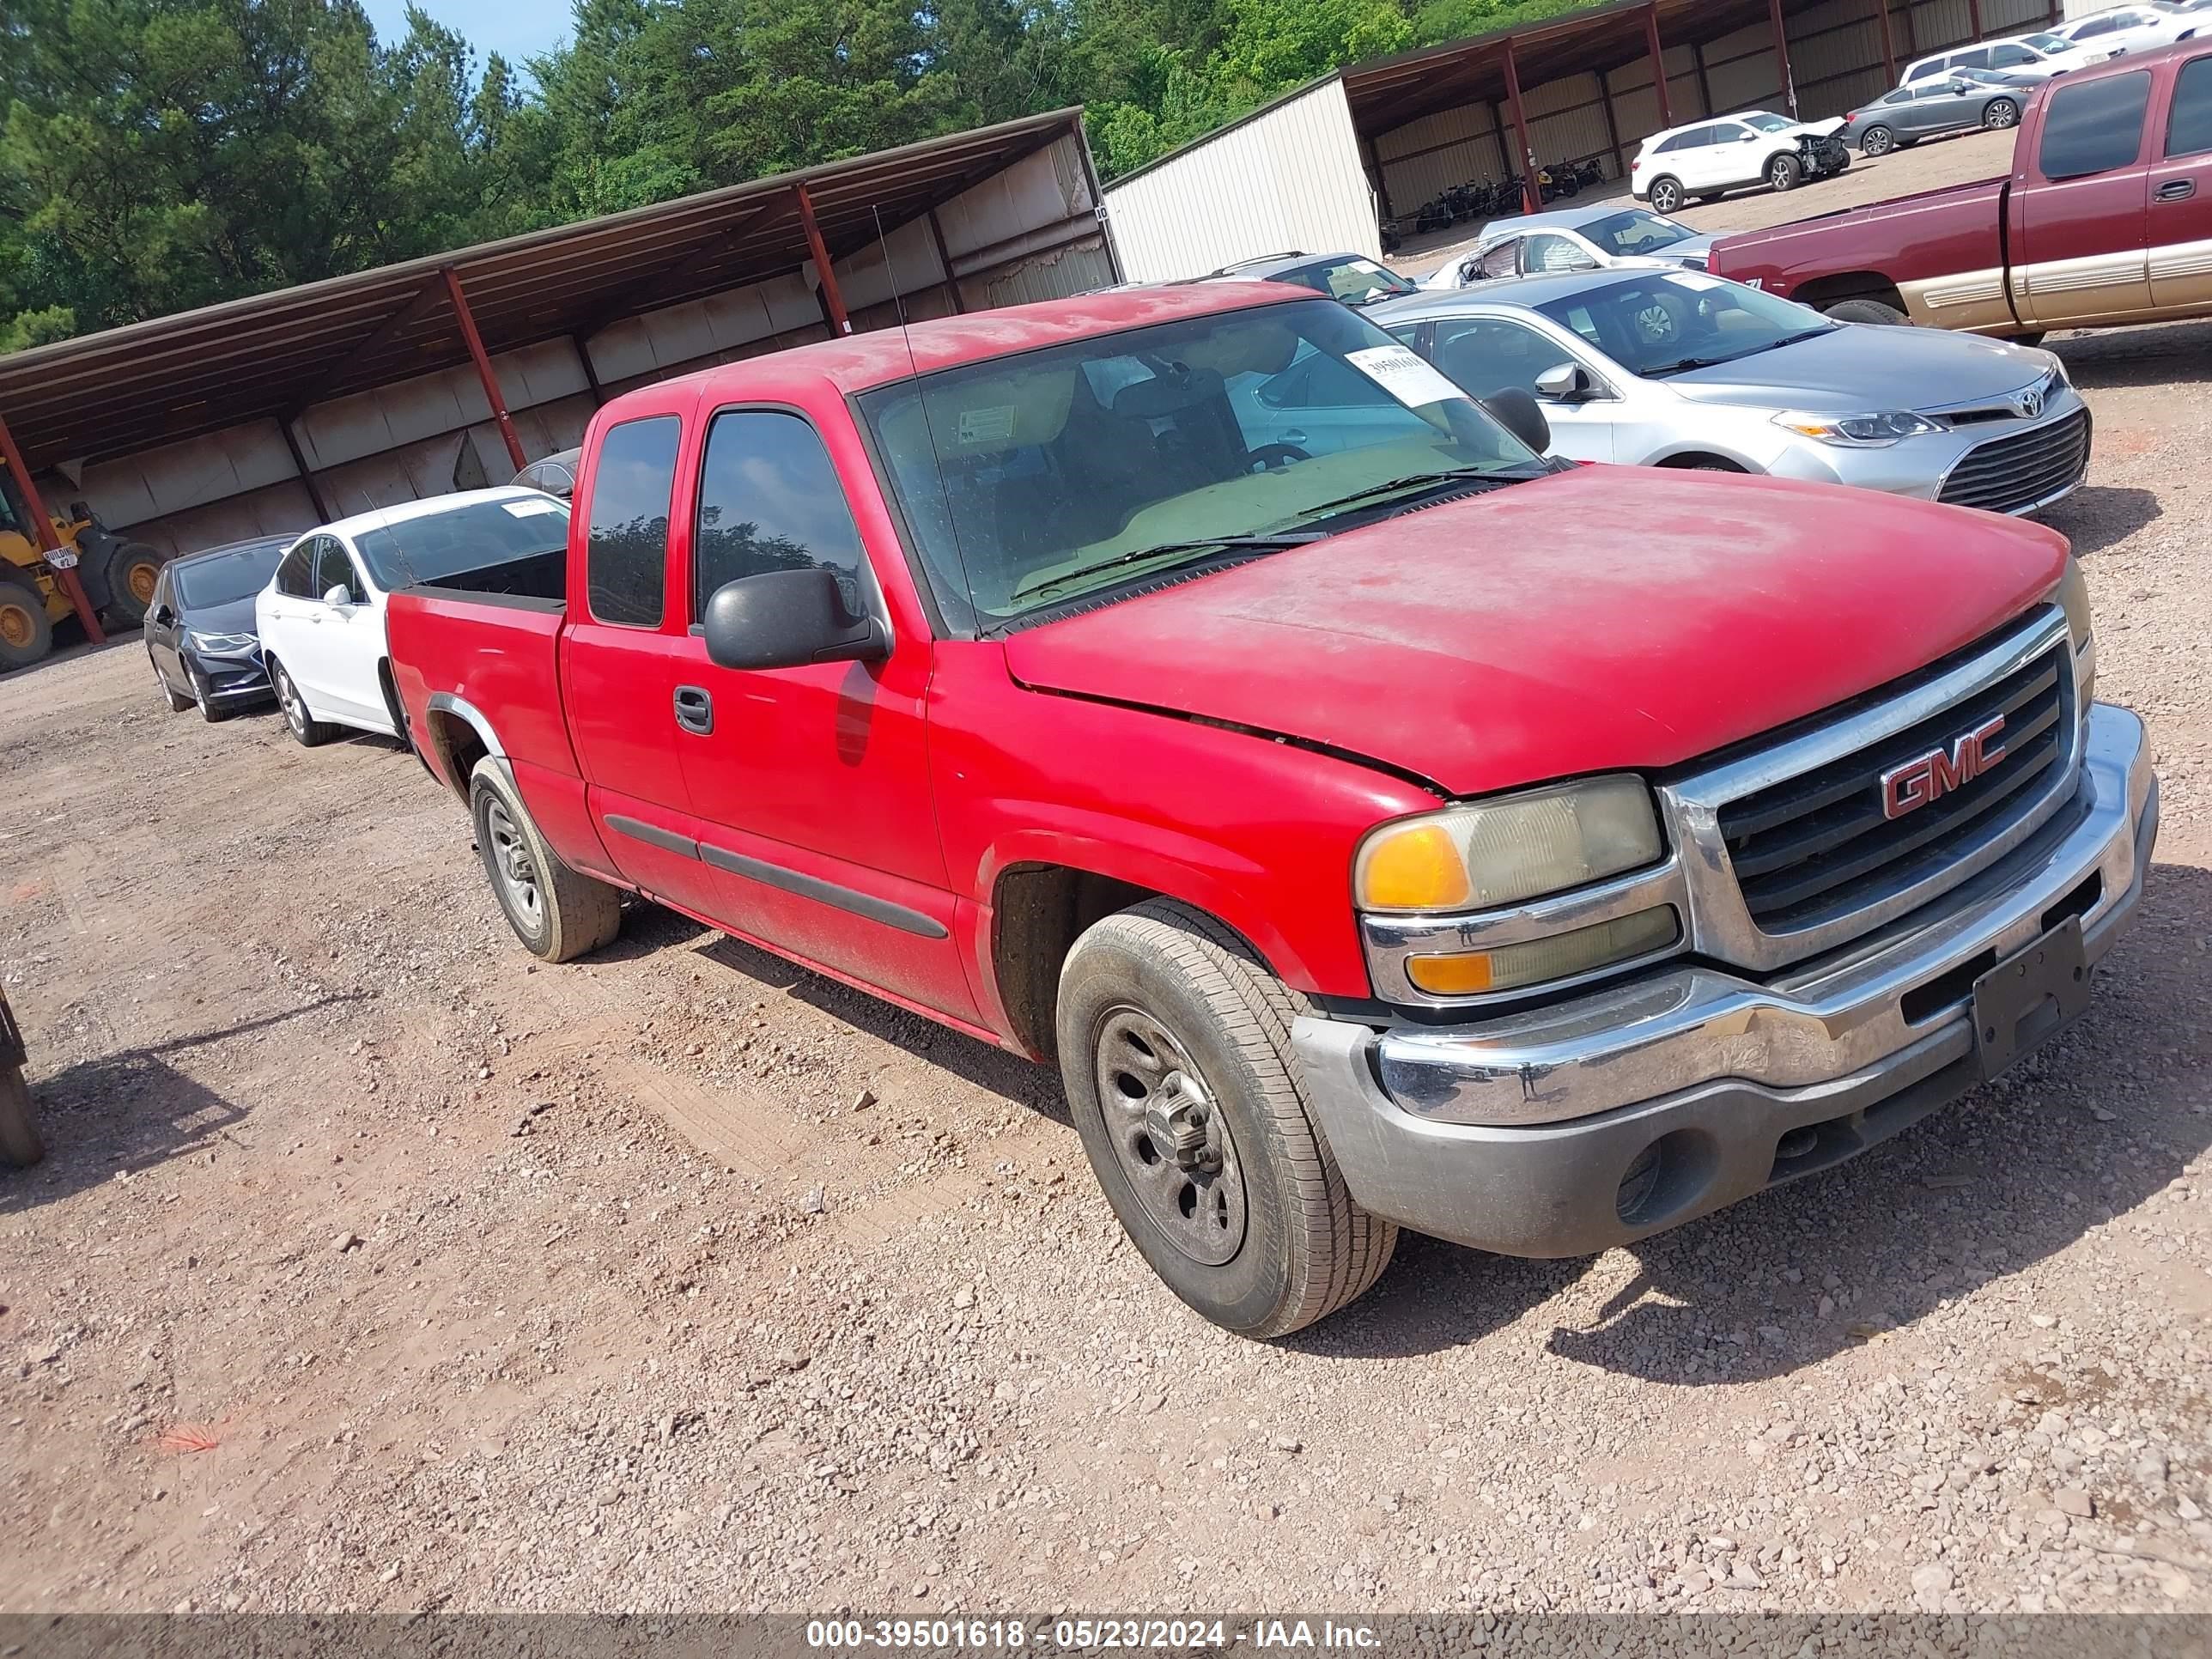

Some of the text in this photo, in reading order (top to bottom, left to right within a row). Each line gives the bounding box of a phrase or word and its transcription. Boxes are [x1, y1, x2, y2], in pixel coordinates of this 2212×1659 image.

[1096, 207, 1108, 218] 10
[1368, 356, 1425, 374] 39501618
[60, 558, 71, 567] #2
[1881, 713, 2007, 820] GMC
[1149, 1121, 1175, 1148] GMC
